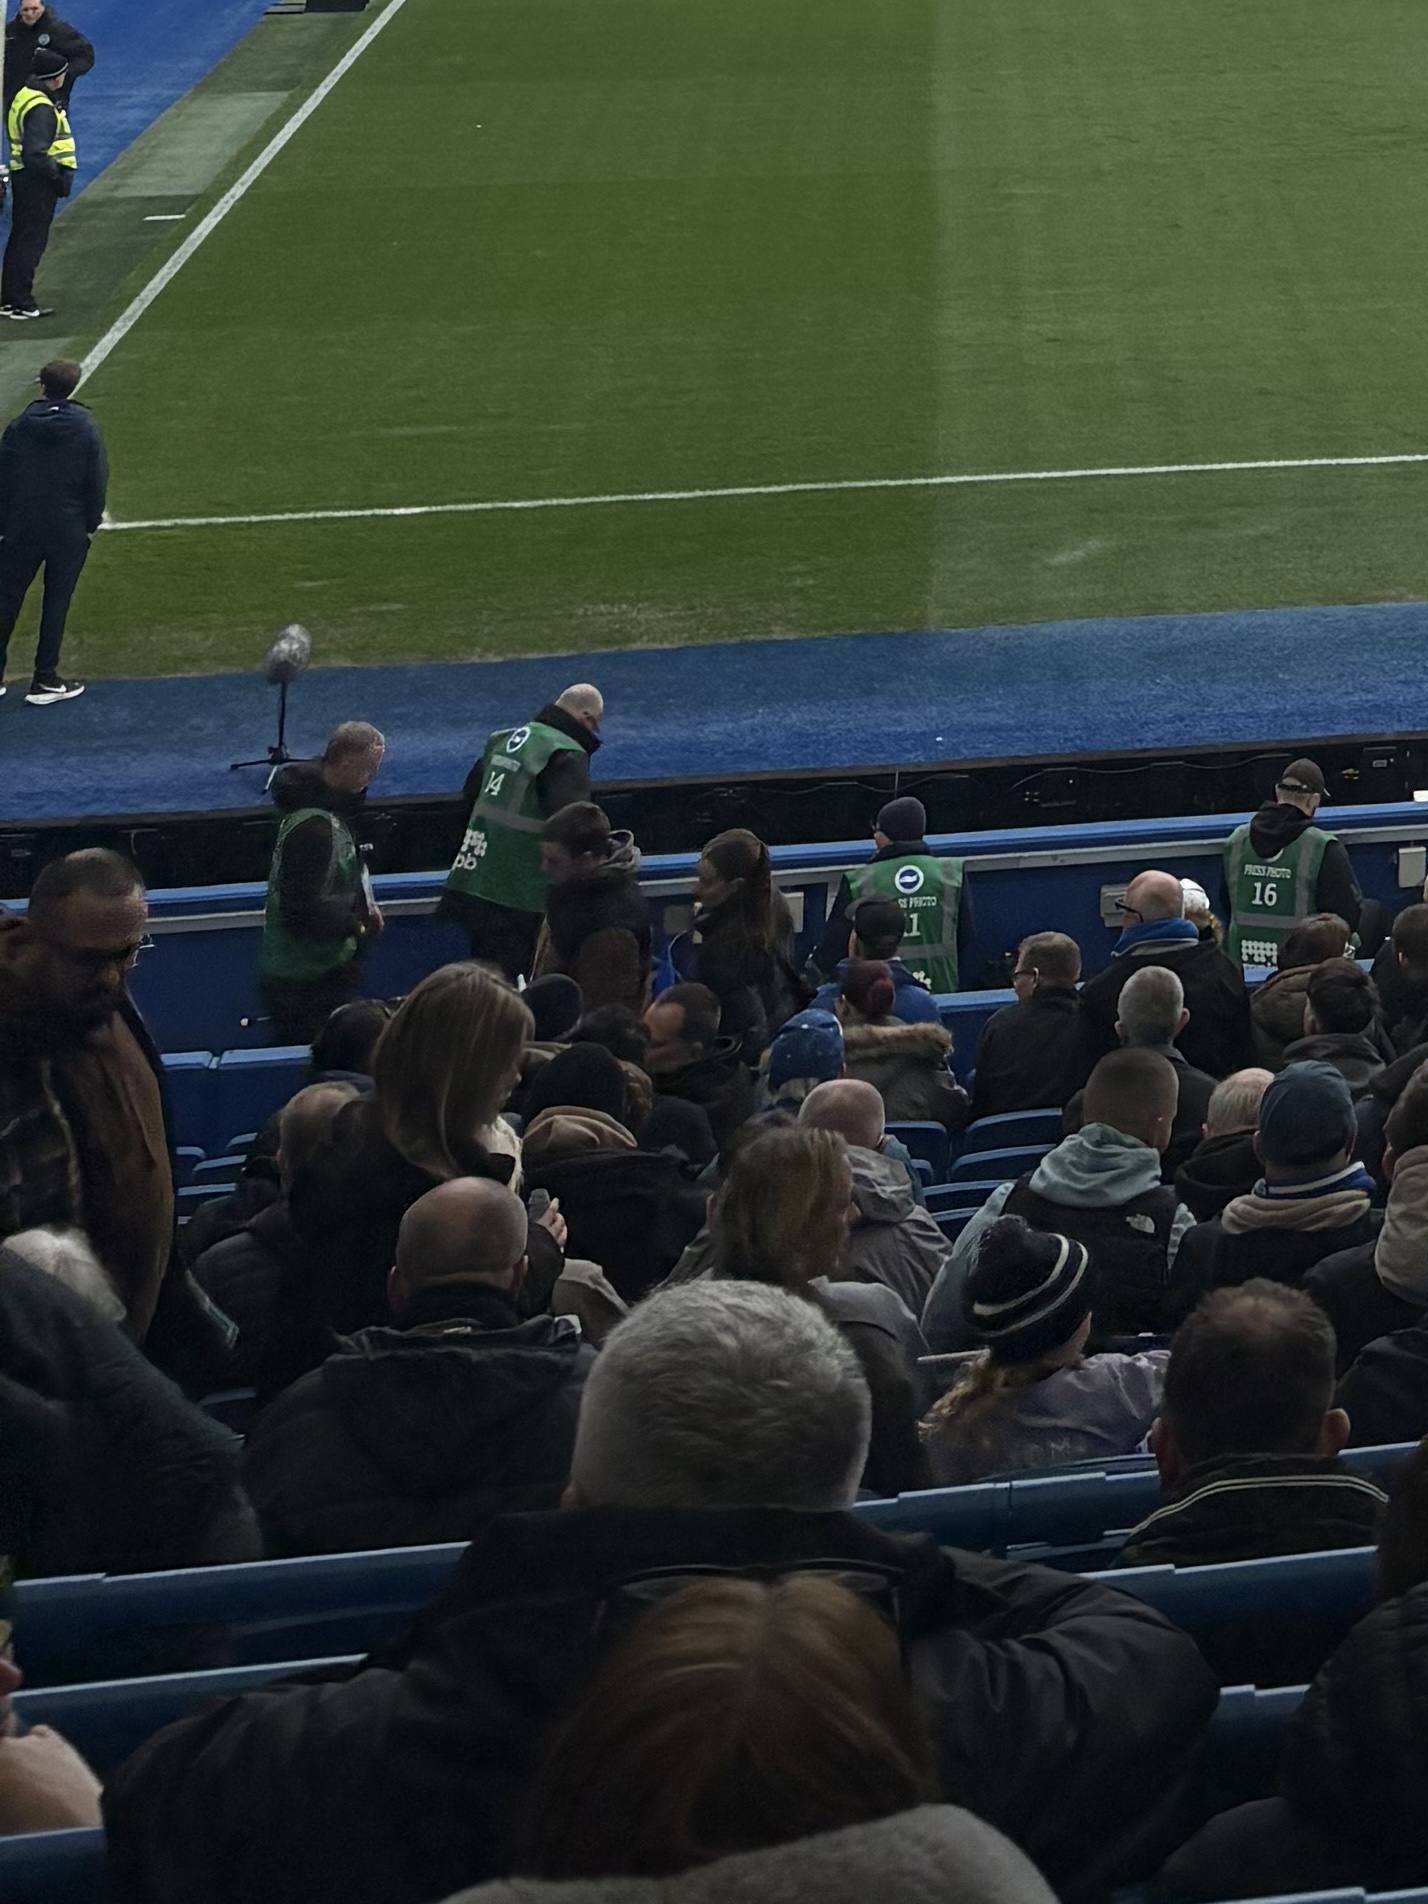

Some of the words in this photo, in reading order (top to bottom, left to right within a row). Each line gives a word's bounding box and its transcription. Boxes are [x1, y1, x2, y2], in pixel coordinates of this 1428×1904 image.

[484, 771, 505, 796] 14
[1244, 863, 1266, 877] PRESS
[1266, 866, 1292, 879] PHOTO
[1251, 881, 1278, 907] 16
